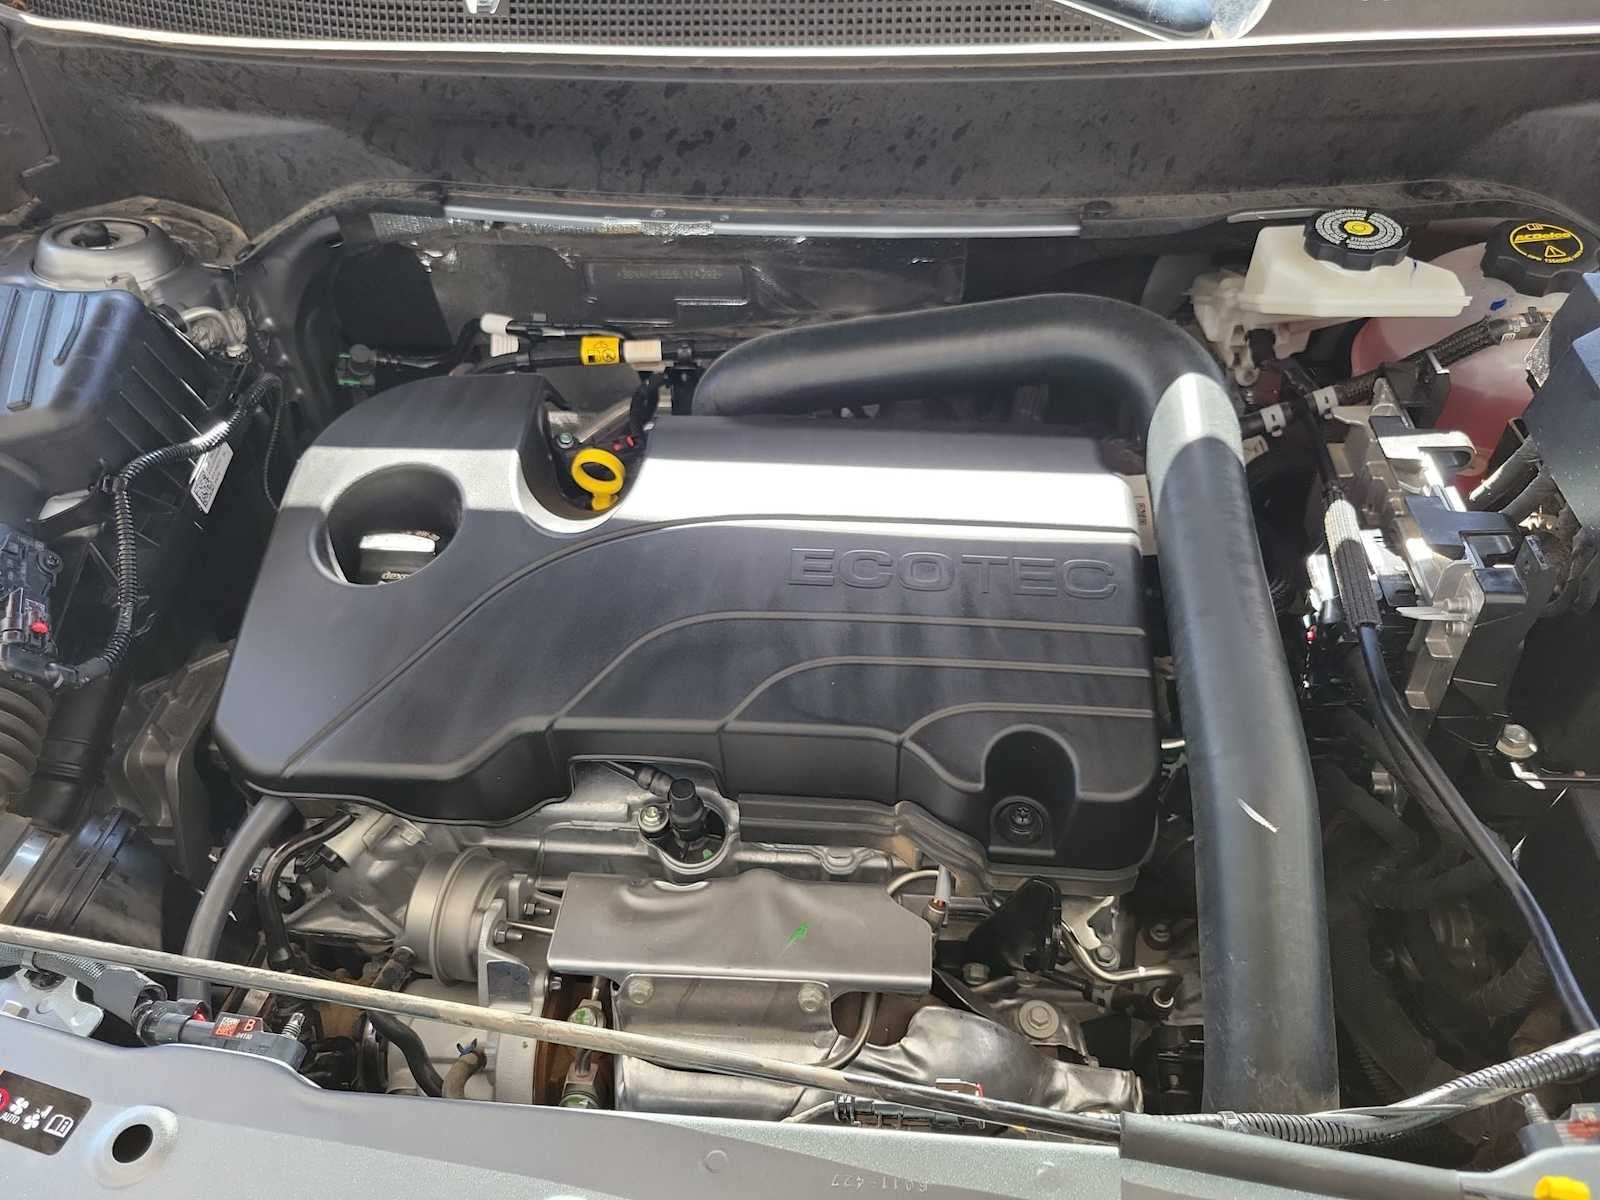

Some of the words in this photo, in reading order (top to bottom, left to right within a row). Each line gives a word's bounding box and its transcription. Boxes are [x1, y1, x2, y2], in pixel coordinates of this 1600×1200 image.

[788, 548, 1117, 599] ECOTEC
[244, 1019, 257, 1032] B
[0, 1112, 20, 1125] AUTO
